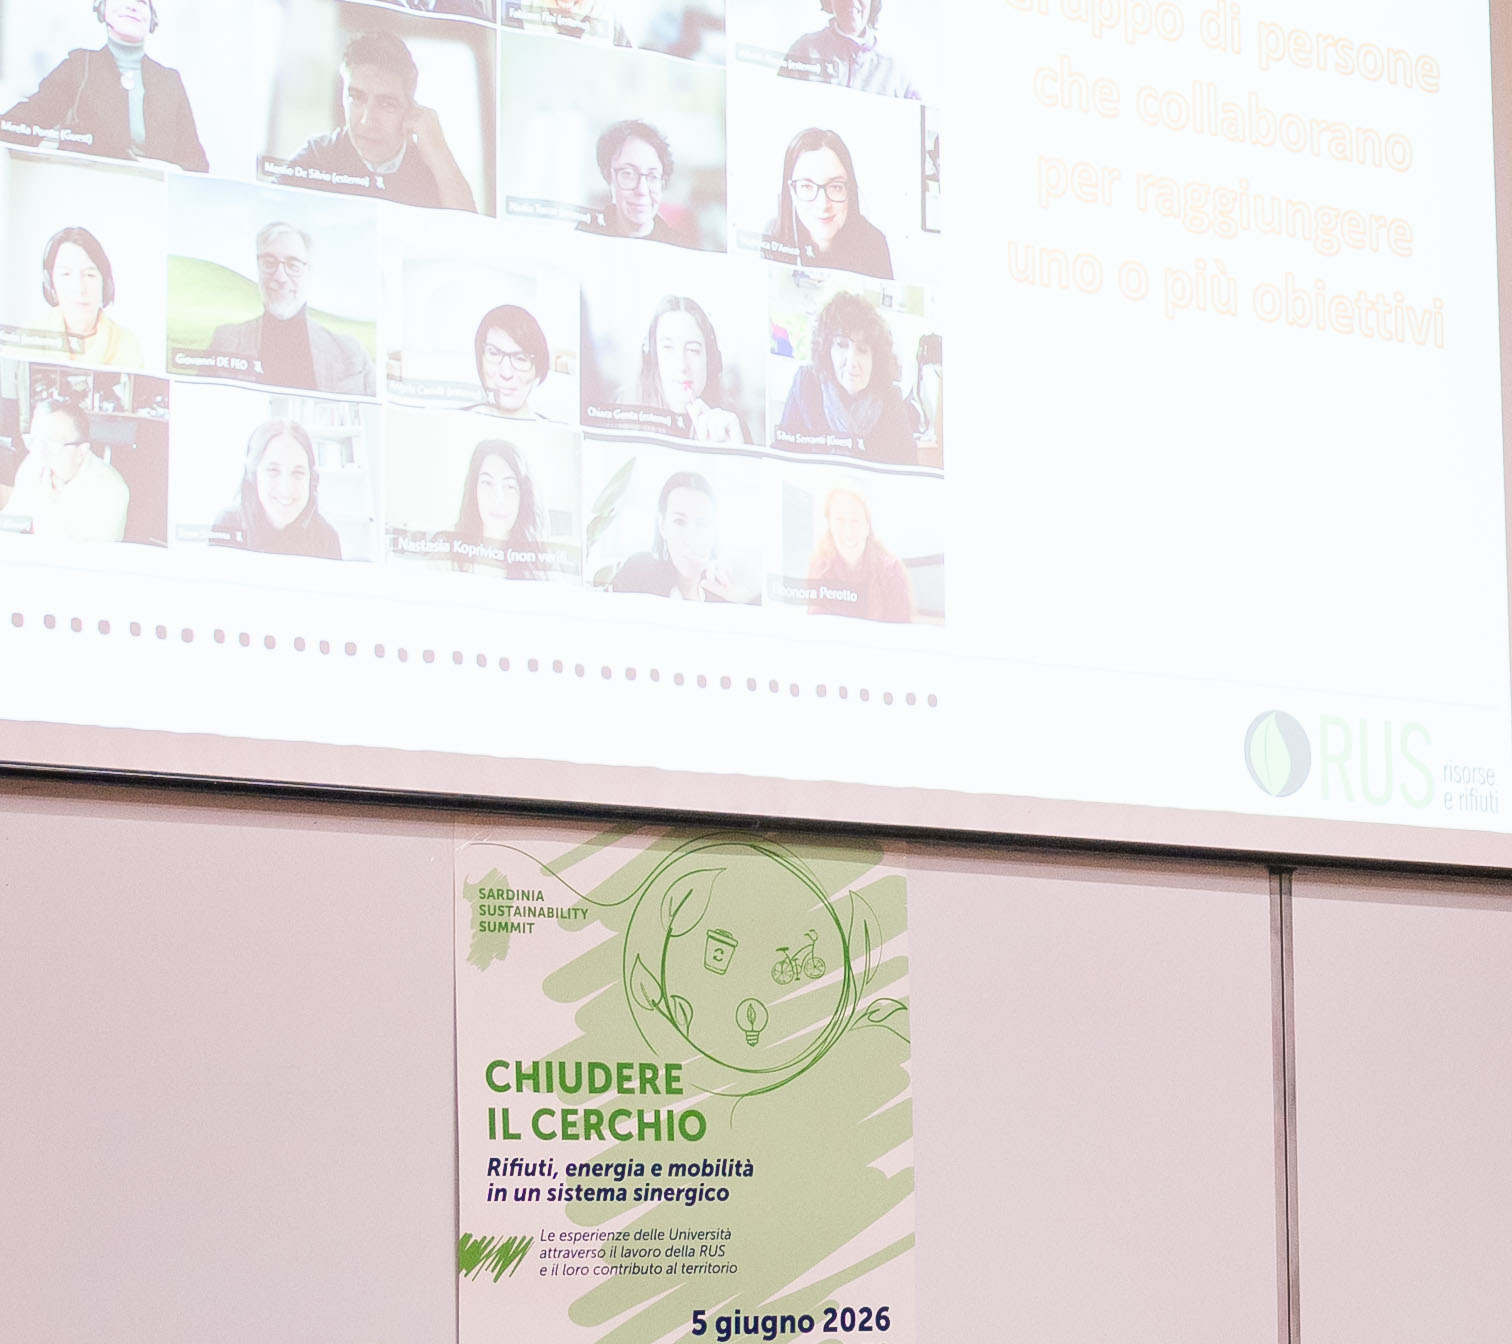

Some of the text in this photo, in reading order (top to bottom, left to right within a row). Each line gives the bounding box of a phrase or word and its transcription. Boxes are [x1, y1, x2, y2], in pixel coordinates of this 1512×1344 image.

[1256, 18, 1442, 94] persone
[1032, 53, 1414, 174] che collaborano
[1036, 154, 1415, 258] per raggiungere
[1006, 239, 1447, 350] uno o più obiettivi
[397, 537, 451, 555] Nastasia
[506, 549, 538, 565] (non
[1320, 713, 1435, 809] RUS
[1442, 759, 1496, 787] risorse
[1443, 789, 1500, 815] e rifiuti
[478, 887, 545, 903] SARDINIA
[478, 903, 589, 921] SUSTAINABILITY
[478, 920, 535, 935] SUMMIT
[485, 1059, 685, 1096] CHIUDERE
[487, 1106, 707, 1143] IL CERCHIO
[487, 1157, 755, 1182] Rifiuti, energia e mobilità
[486, 1182, 730, 1206] in un sistema sinergico
[539, 1227, 733, 1246] Le esperienze delle Università
[539, 1244, 726, 1260] attraverso il lavoro della RUS
[539, 1260, 739, 1277] e il loro contributo al territorio
[691, 1306, 892, 1342] 5 giugno 2026
